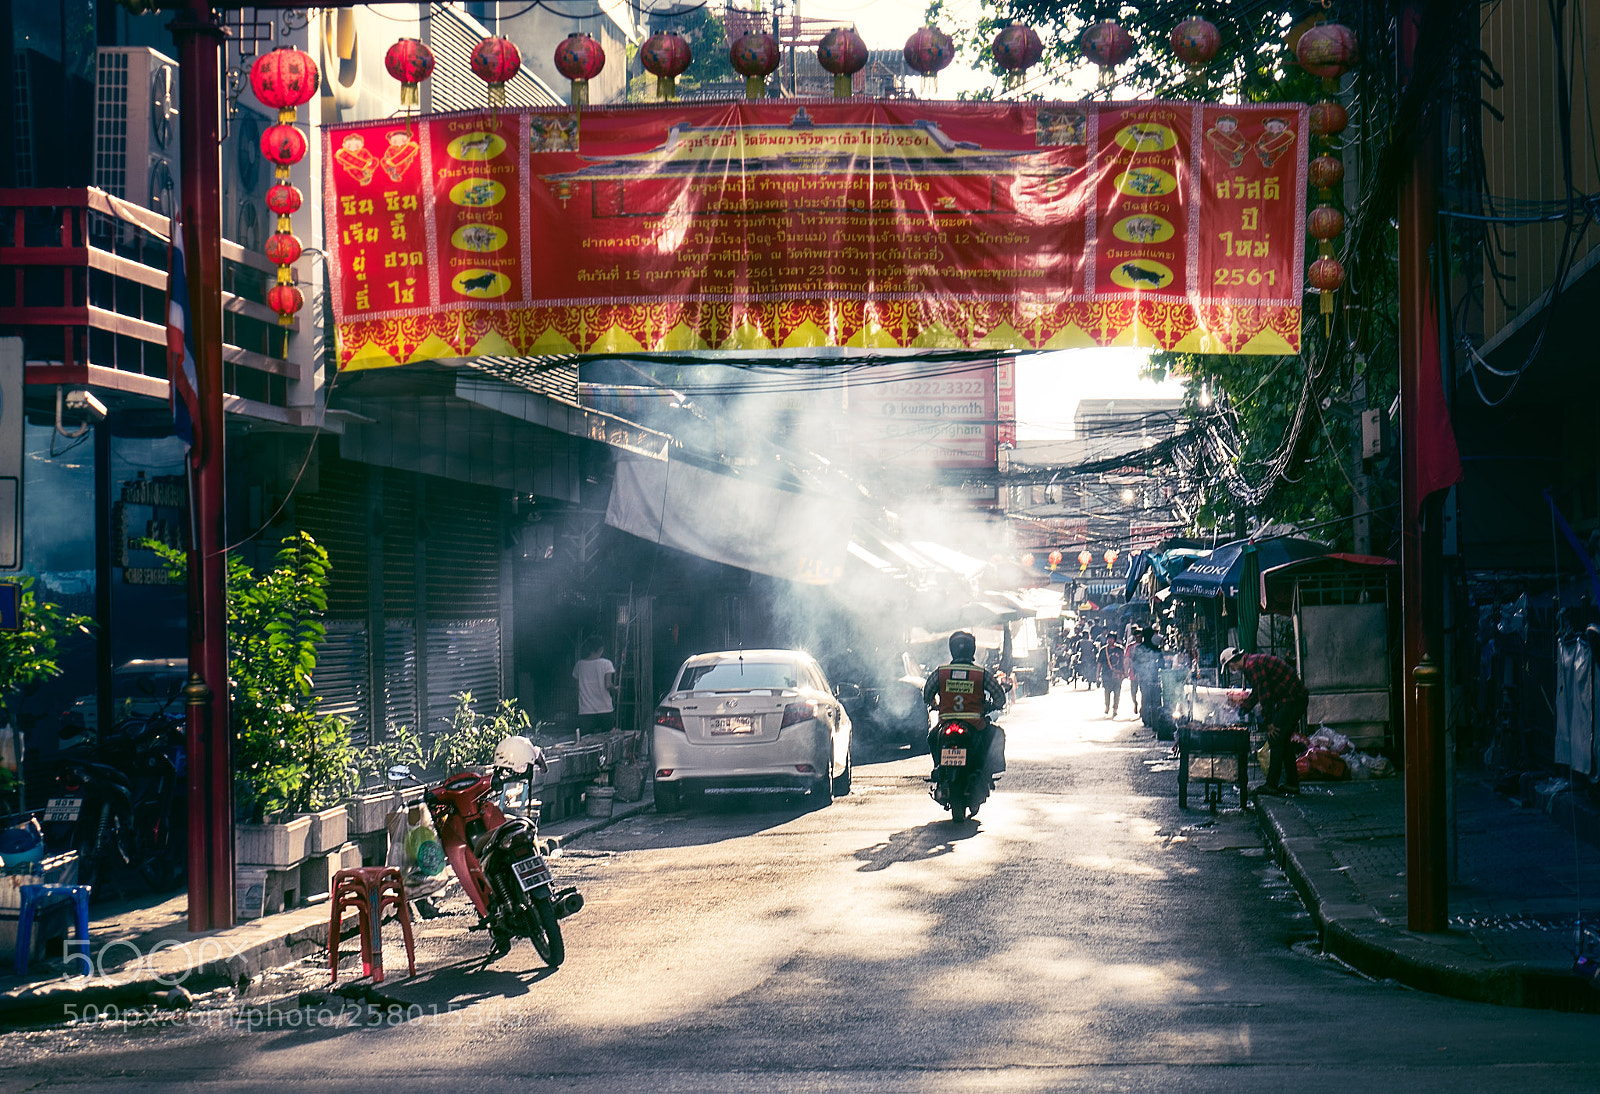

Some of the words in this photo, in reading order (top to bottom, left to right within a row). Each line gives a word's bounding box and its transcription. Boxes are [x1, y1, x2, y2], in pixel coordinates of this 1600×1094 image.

[1216, 176, 1280, 200] สวัสดี
[1240, 207, 1259, 231] ปี
[954, 234, 970, 243] 12
[1218, 231, 1270, 258] ใหม่
[384, 251, 424, 268] ฮวด
[625, 270, 640, 280] 15
[645, 266, 708, 280] กุมภาพันธ์
[746, 268, 774, 278] 2561
[809, 265, 846, 275] 23.00
[1214, 268, 1276, 287] 2561
[901, 402, 982, 417] kwanghamth
[1186, 562, 1230, 575] HIOKI
[953, 694, 965, 712] 3
